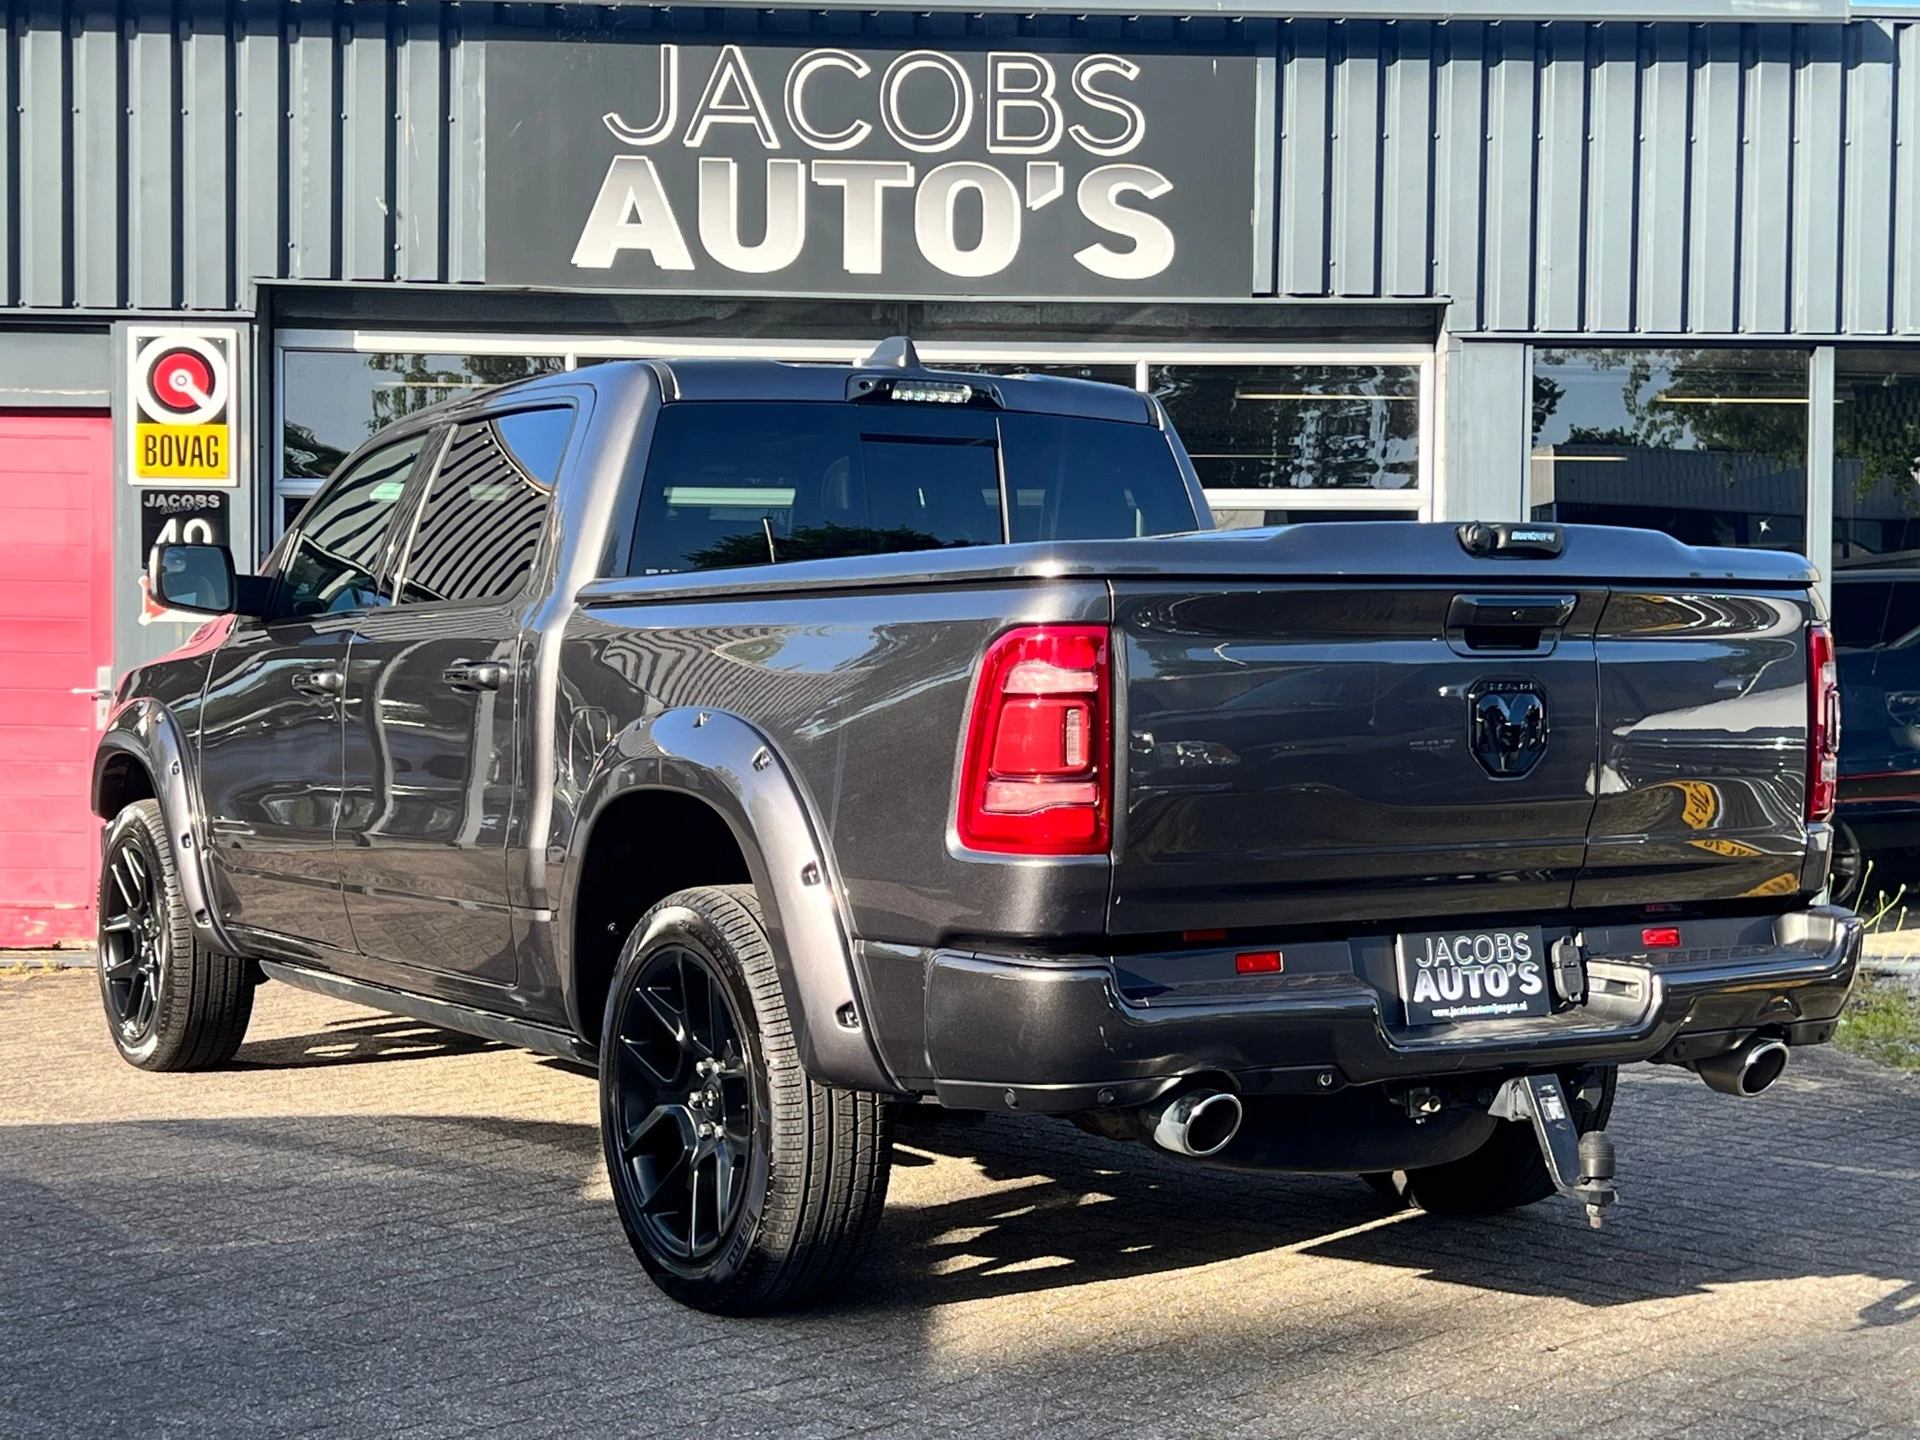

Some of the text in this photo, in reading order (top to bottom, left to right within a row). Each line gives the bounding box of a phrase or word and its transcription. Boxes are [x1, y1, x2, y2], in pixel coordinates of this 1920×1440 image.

[602, 44, 1146, 157] JACOBS
[570, 154, 1175, 280] AUTO'S
[145, 434, 219, 468] BOVAG
[144, 494, 220, 508] JACOBS
[1415, 931, 1532, 968] JACOBS
[1412, 962, 1543, 1004] AUTO'S
